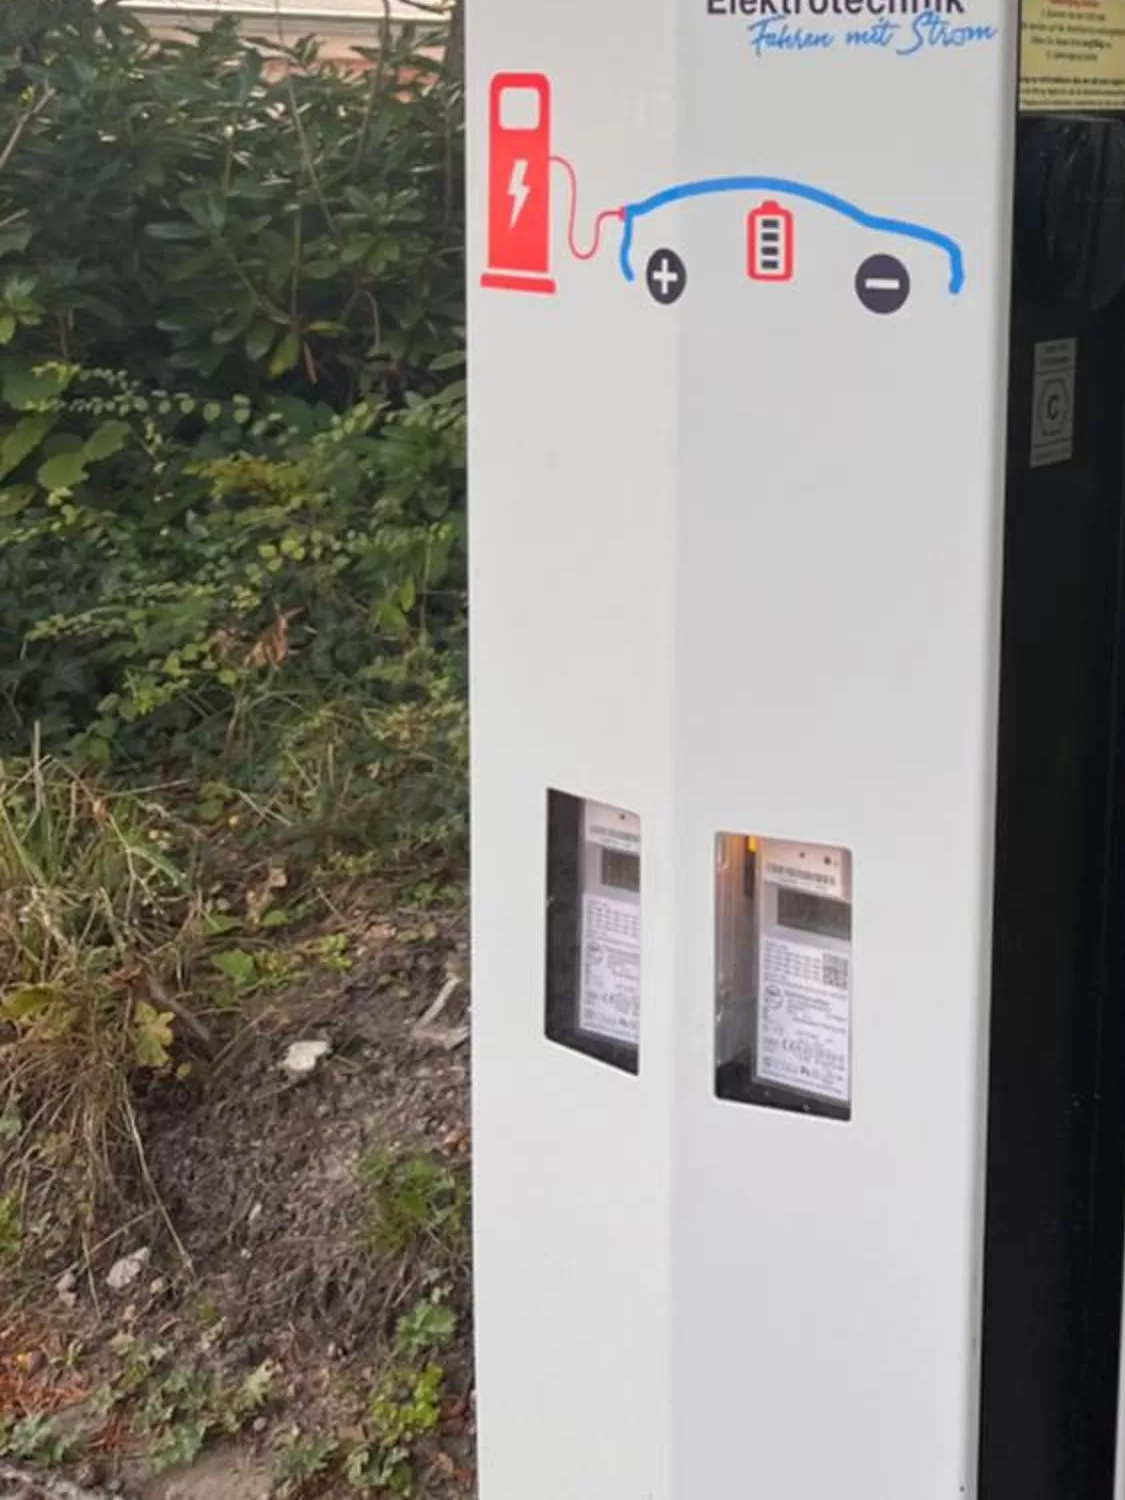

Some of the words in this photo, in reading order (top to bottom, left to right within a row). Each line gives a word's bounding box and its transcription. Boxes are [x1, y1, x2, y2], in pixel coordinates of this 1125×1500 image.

[748, 14, 834, 56] Fahren
[845, 18, 899, 49] mit
[896, 9, 997, 55] Strom
